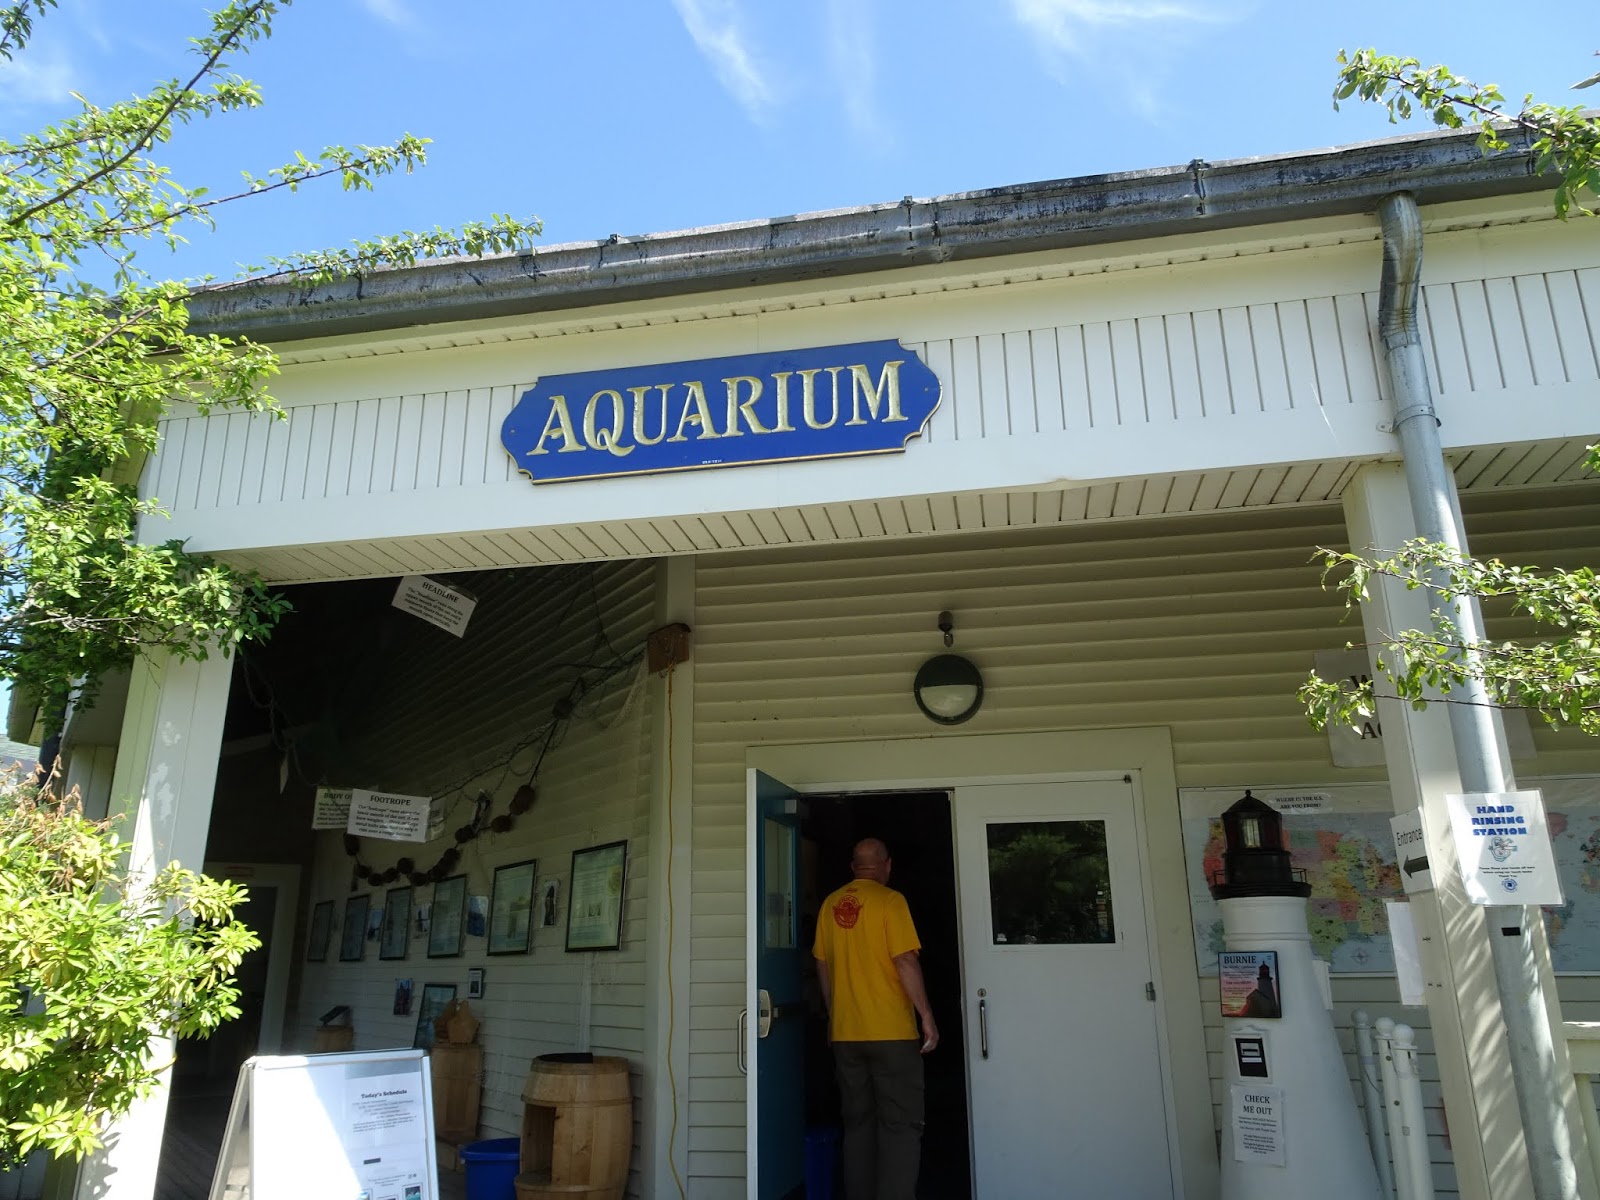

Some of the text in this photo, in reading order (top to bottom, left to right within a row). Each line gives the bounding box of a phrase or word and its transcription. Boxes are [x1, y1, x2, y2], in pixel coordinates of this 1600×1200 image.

[526, 360, 909, 457] AQUARIUM
[422, 581, 459, 603] HEADLINE
[370, 795, 411, 805] FOOTROPE
[1476, 805, 1514, 814] HAND
[1471, 816, 1525, 825] RINSING
[1473, 827, 1527, 836] STATION
[1396, 828, 1422, 847] Entrance
[1224, 955, 1257, 964] BURNIE
[383, 1089, 407, 1097] Schedule
[1244, 1094, 1270, 1104] CHECK
[1242, 1105, 1273, 1115] ME OUT
